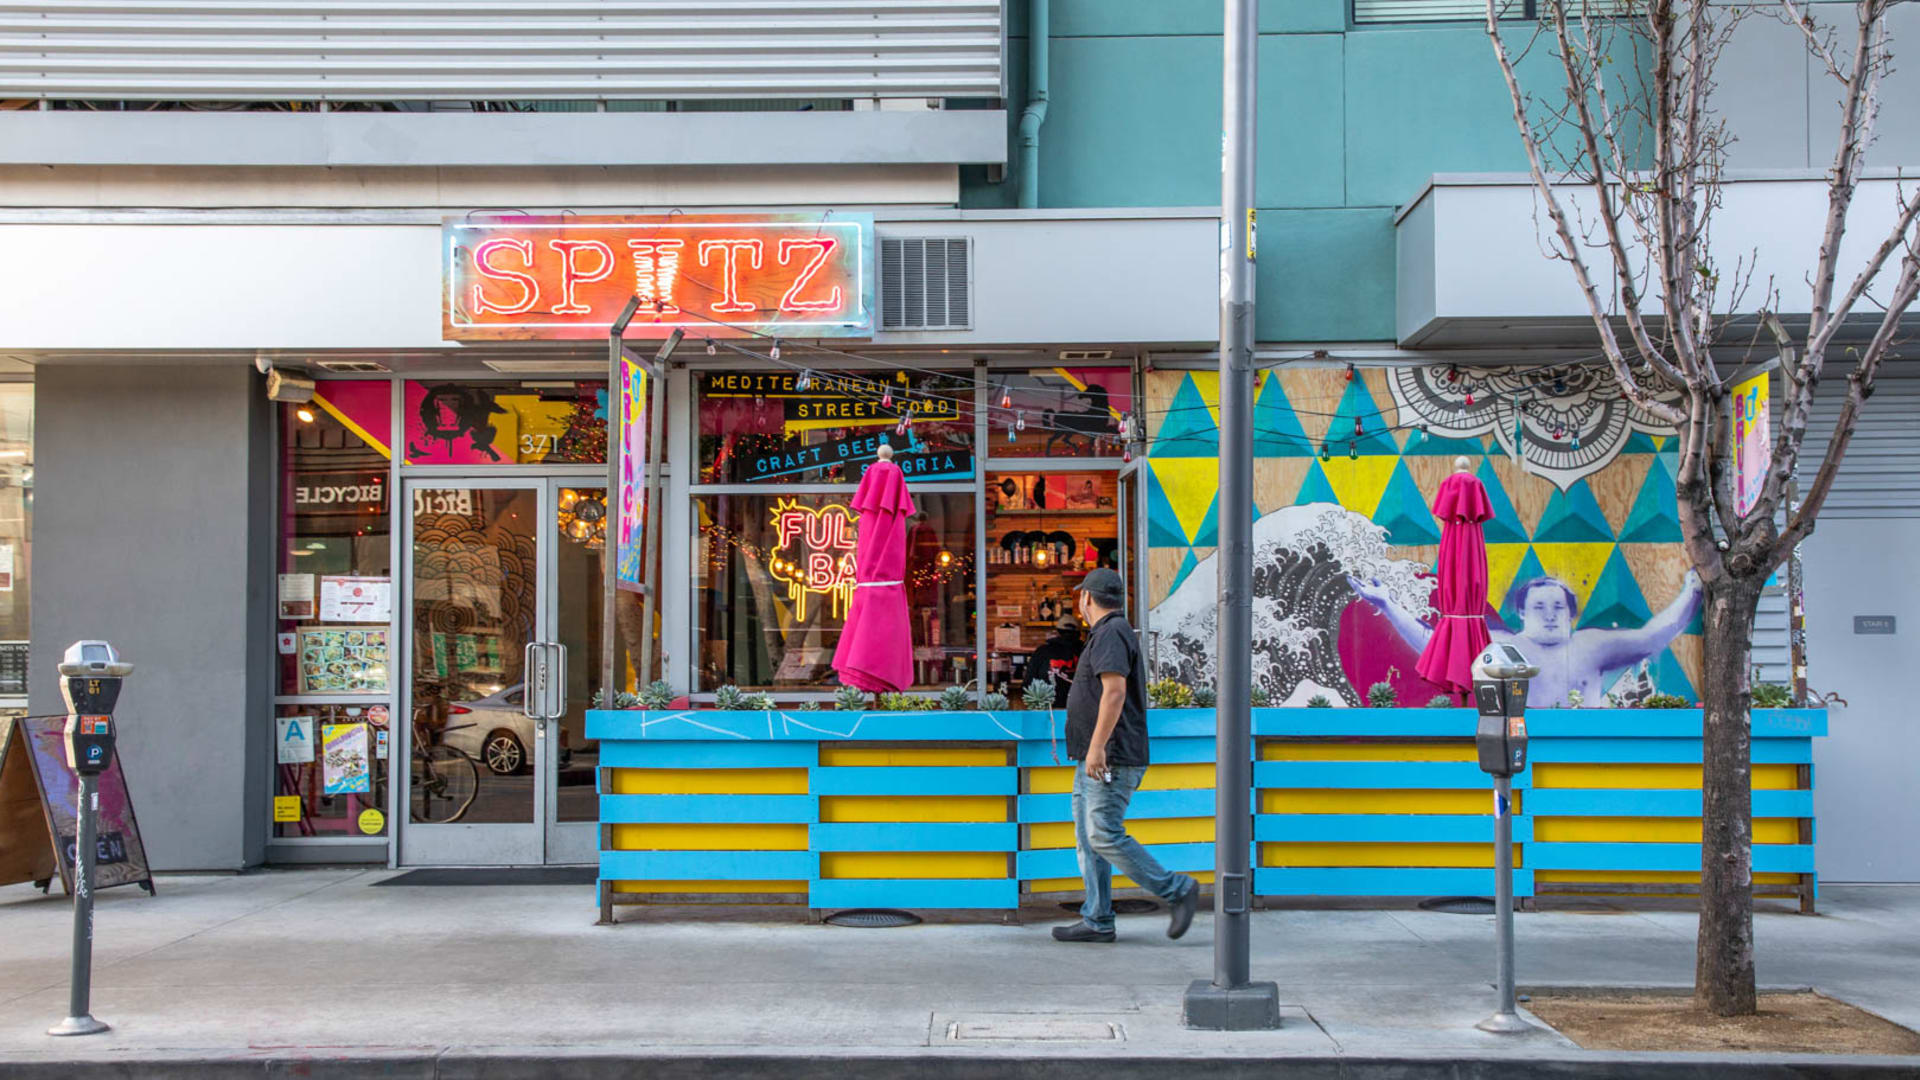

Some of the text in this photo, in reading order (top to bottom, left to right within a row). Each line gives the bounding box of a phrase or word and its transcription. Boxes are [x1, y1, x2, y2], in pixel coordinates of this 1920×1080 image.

[473, 238, 842, 314] SPITZ
[711, 376, 890, 392] MEDITERANEAN
[798, 399, 949, 417] STREET FOOD
[520, 433, 558, 454] 371
[621, 361, 634, 544] BRUNCH
[756, 447, 821, 473] CRAFT
[860, 456, 956, 476] SGRIA
[780, 512, 857, 550] FUL
[808, 552, 858, 590] BA
[285, 720, 305, 741] A
[66, 840, 123, 860] OEN
